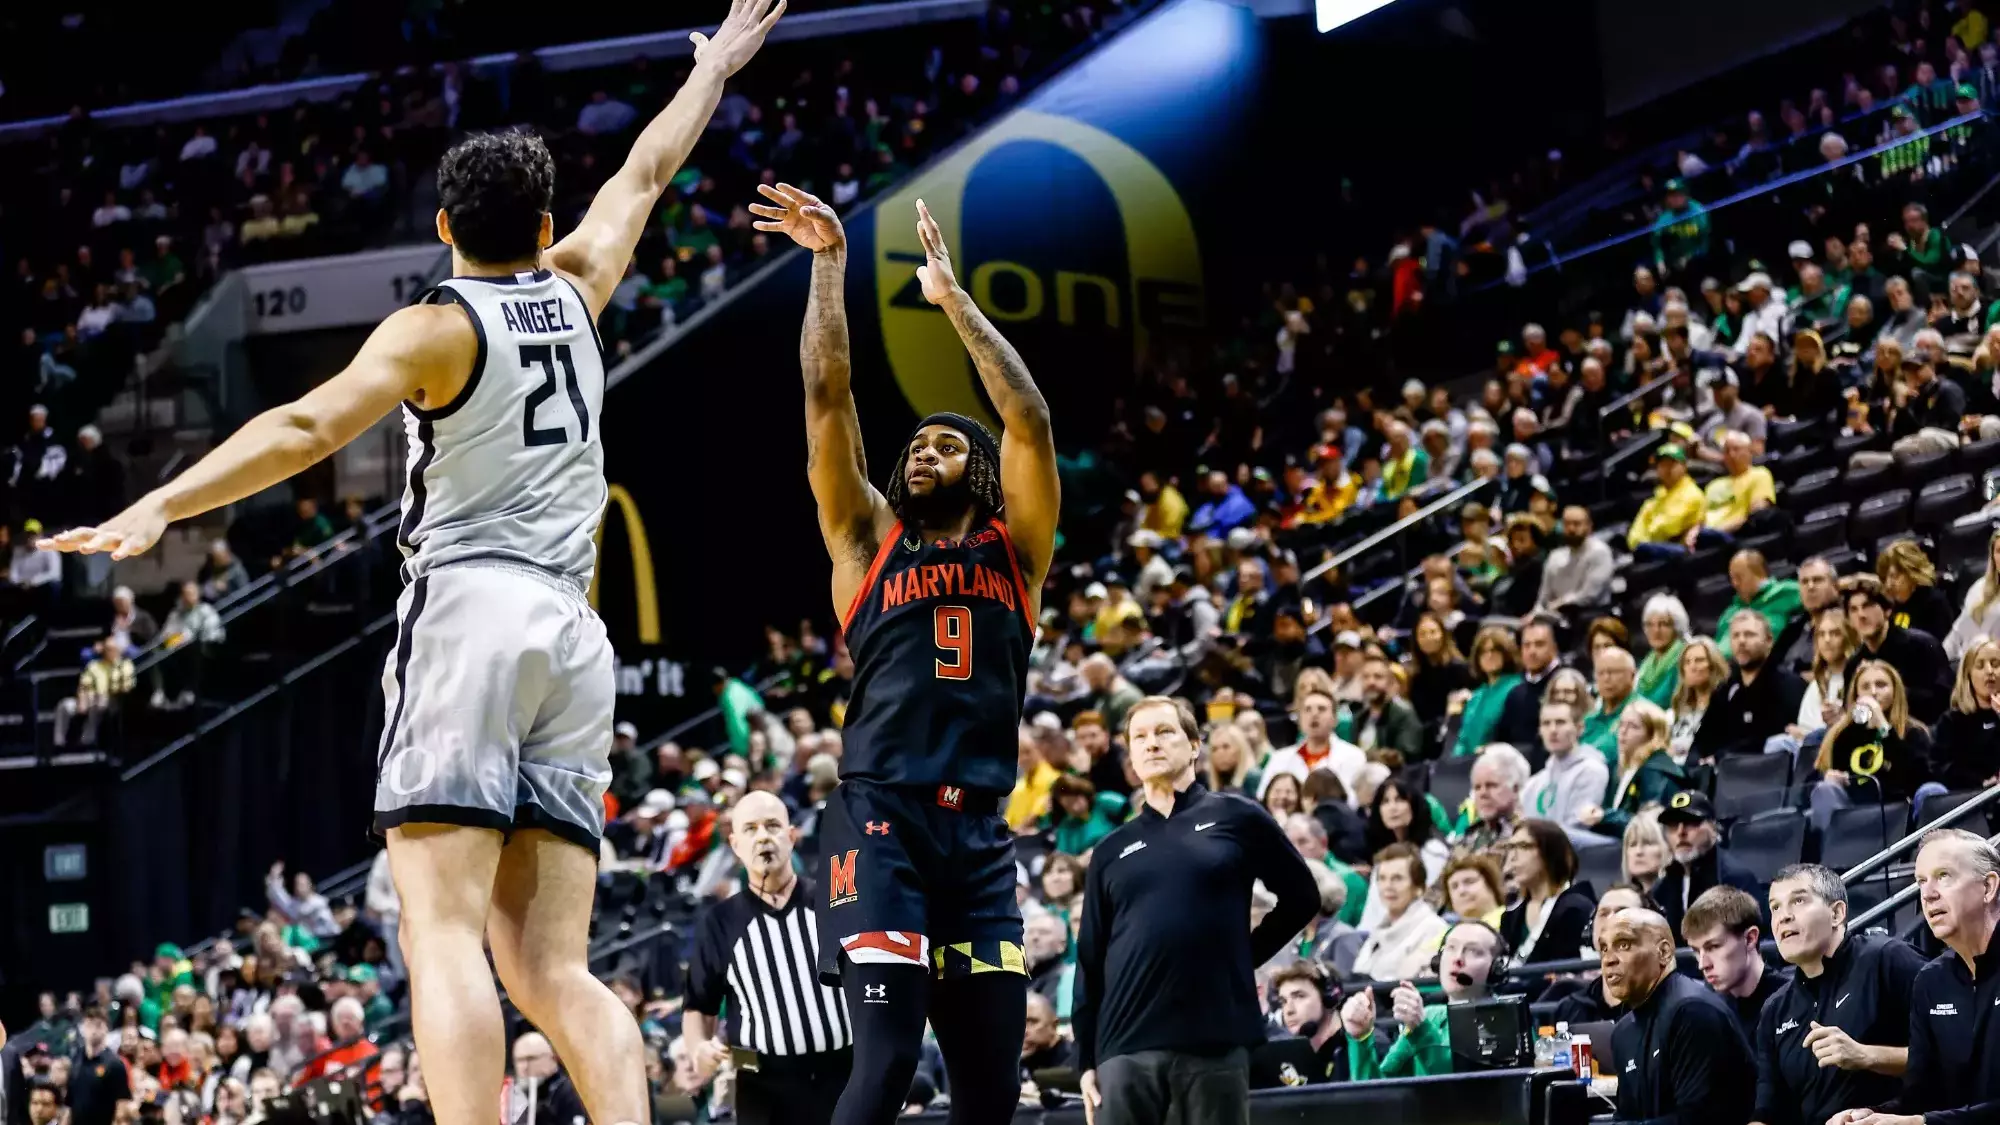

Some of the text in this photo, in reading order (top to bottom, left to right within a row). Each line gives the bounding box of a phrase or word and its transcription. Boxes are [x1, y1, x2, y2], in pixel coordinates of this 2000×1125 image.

[255, 287, 306, 316] 120
[501, 298, 573, 333] ANGEL
[519, 344, 589, 446] 21
[882, 563, 1015, 613] MARYLAND
[933, 605, 972, 680] 9
[658, 657, 685, 698] it
[944, 785, 961, 805] M
[830, 849, 860, 901] M
